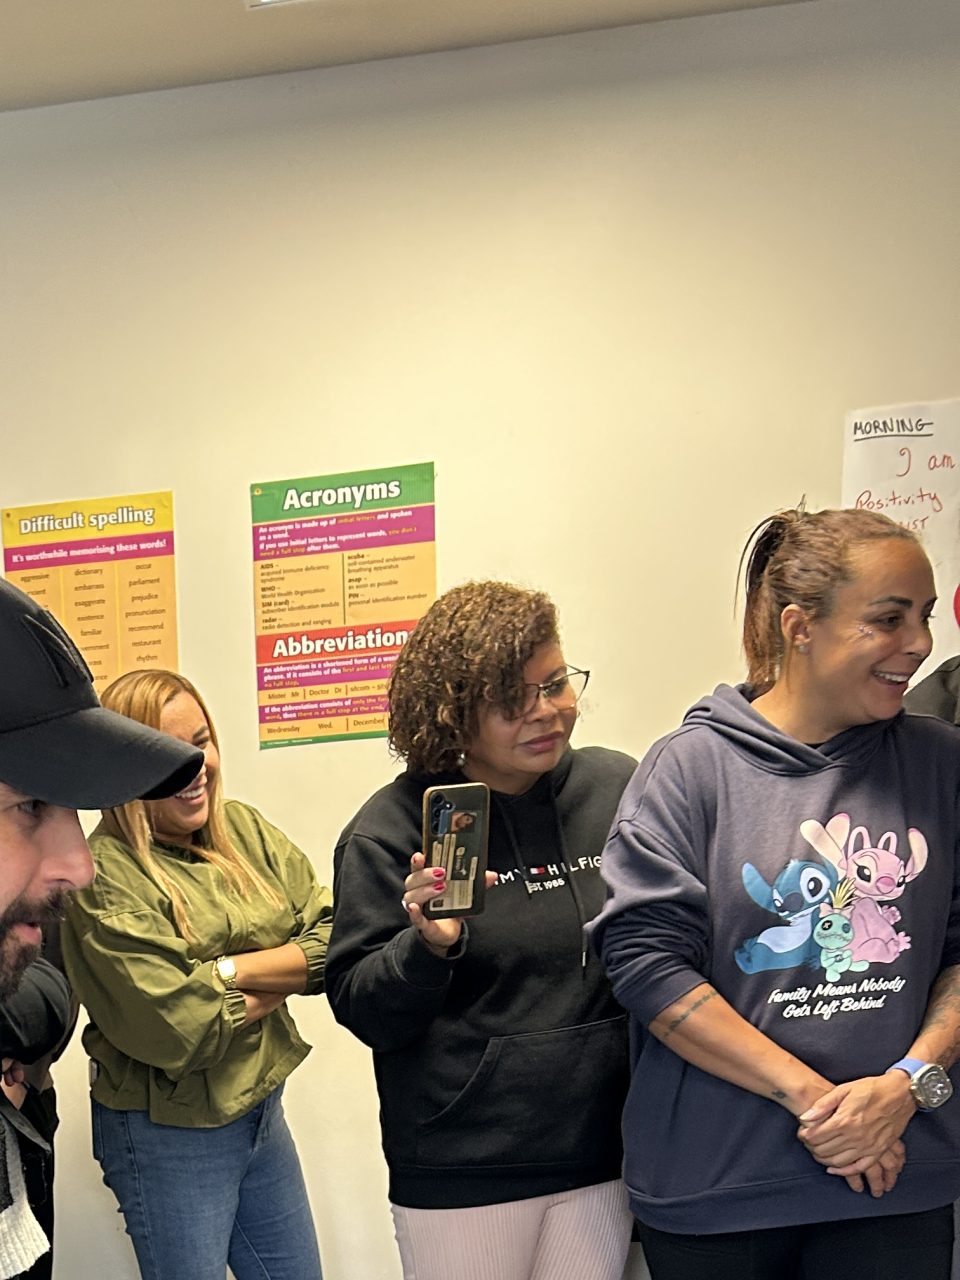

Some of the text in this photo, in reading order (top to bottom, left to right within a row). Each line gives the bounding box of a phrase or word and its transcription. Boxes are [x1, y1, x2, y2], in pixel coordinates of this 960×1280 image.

[854, 418, 934, 434] MORNING
[928, 454, 955, 470] am
[283, 480, 401, 510] Acronyms
[856, 488, 943, 512] Positivity
[20, 508, 154, 534] Difficult spelling
[269, 523, 294, 533] acronym
[302, 520, 318, 528] made
[377, 512, 388, 520] and
[390, 510, 412, 518] spoken
[265, 542, 276, 550] you
[290, 538, 306, 546] initial
[308, 536, 327, 544] letters
[337, 533, 366, 542] represent
[307, 544, 321, 552] after
[12, 539, 166, 563] It's worthwhile memorising these words!
[74, 568, 103, 576] dictionary
[129, 577, 160, 587] parliament
[132, 593, 158, 602] prejudice
[125, 608, 166, 618] pronunciation
[81, 628, 102, 636] familiar
[128, 623, 164, 632] recommend
[132, 639, 161, 647] restaurant
[273, 629, 412, 657] Abbreviation
[136, 654, 157, 663] rhythm
[274, 663, 310, 672] abbreviation
[323, 659, 352, 668] shortened
[354, 657, 368, 665] form
[299, 670, 323, 678] consists
[282, 702, 318, 712] abbreviation
[338, 707, 350, 715] stop
[267, 725, 300, 734] Wednesday
[354, 718, 384, 726] December
[767, 976, 906, 1004] Family Means Nobody
[783, 995, 886, 1020] Gets Left Behind
